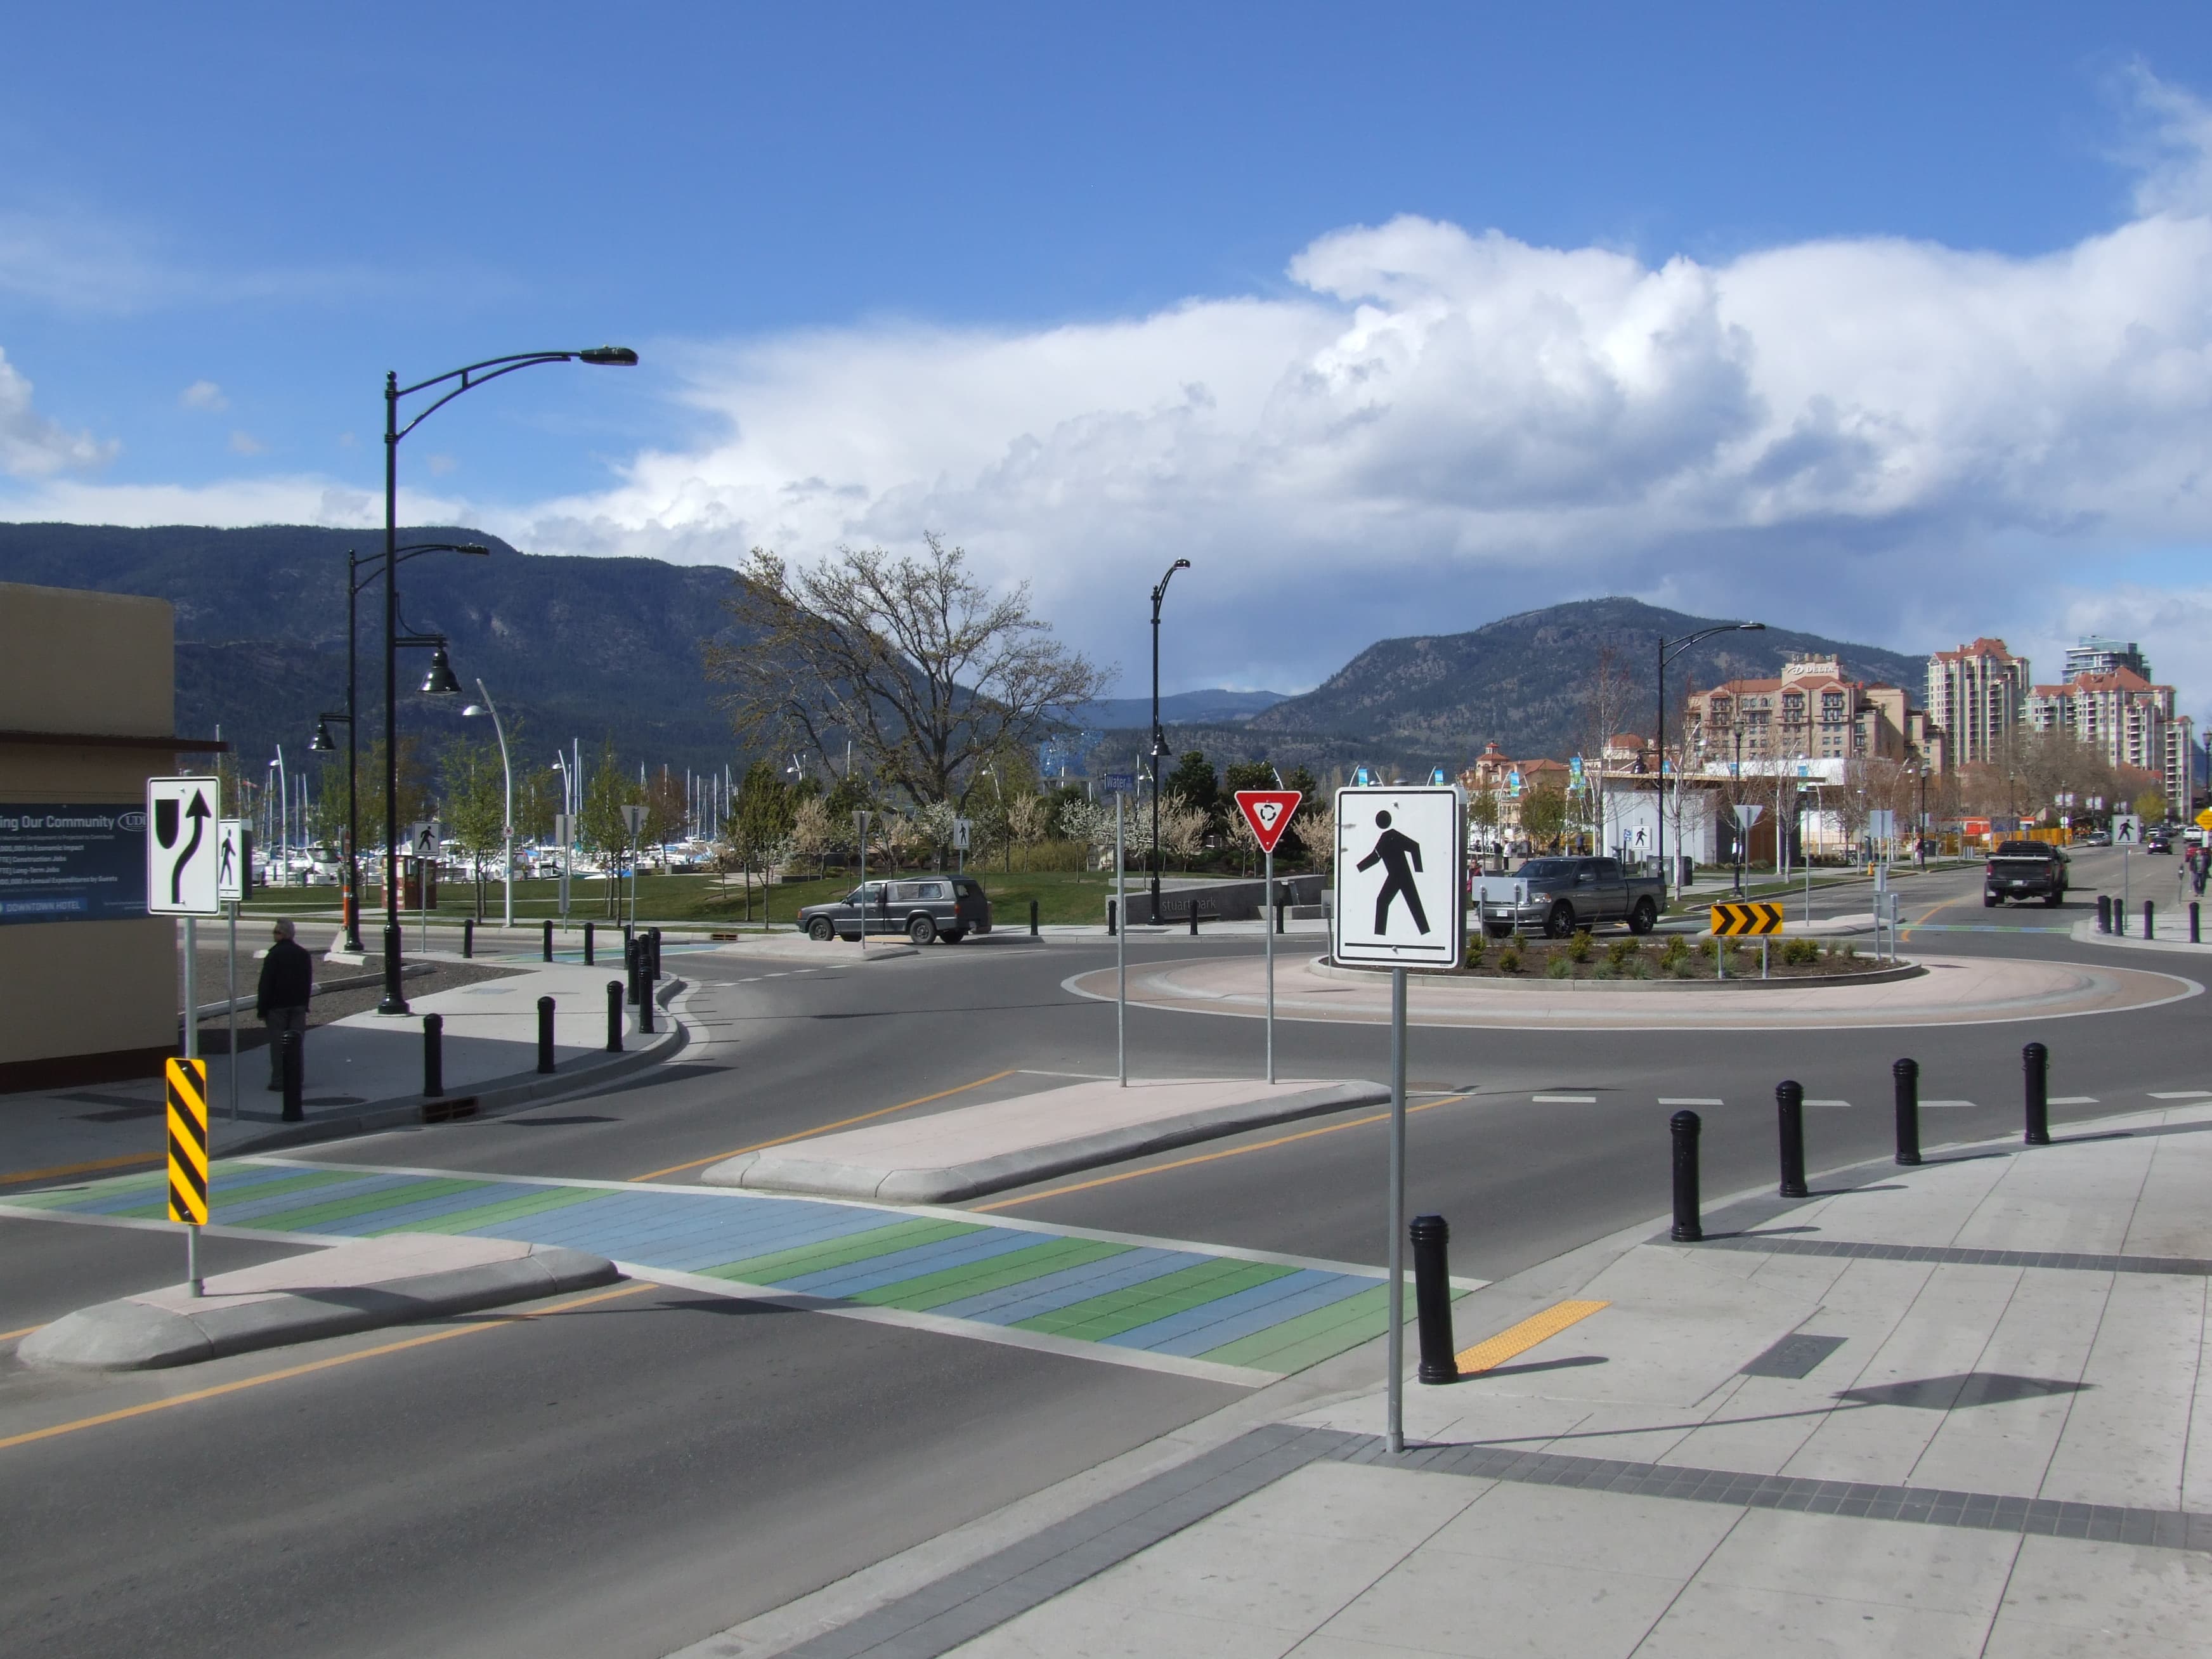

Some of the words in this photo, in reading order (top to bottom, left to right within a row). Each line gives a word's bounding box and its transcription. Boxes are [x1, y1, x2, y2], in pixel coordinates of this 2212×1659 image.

[1806, 665, 1834, 673] DELTA
[1107, 776, 1126, 788] Water
[22, 816, 43, 828] Our
[46, 816, 114, 831] Community
[6, 902, 55, 912] DOWNTOWN
[56, 901, 81, 909] HOTEL
[1162, 899, 1190, 911] stuart
